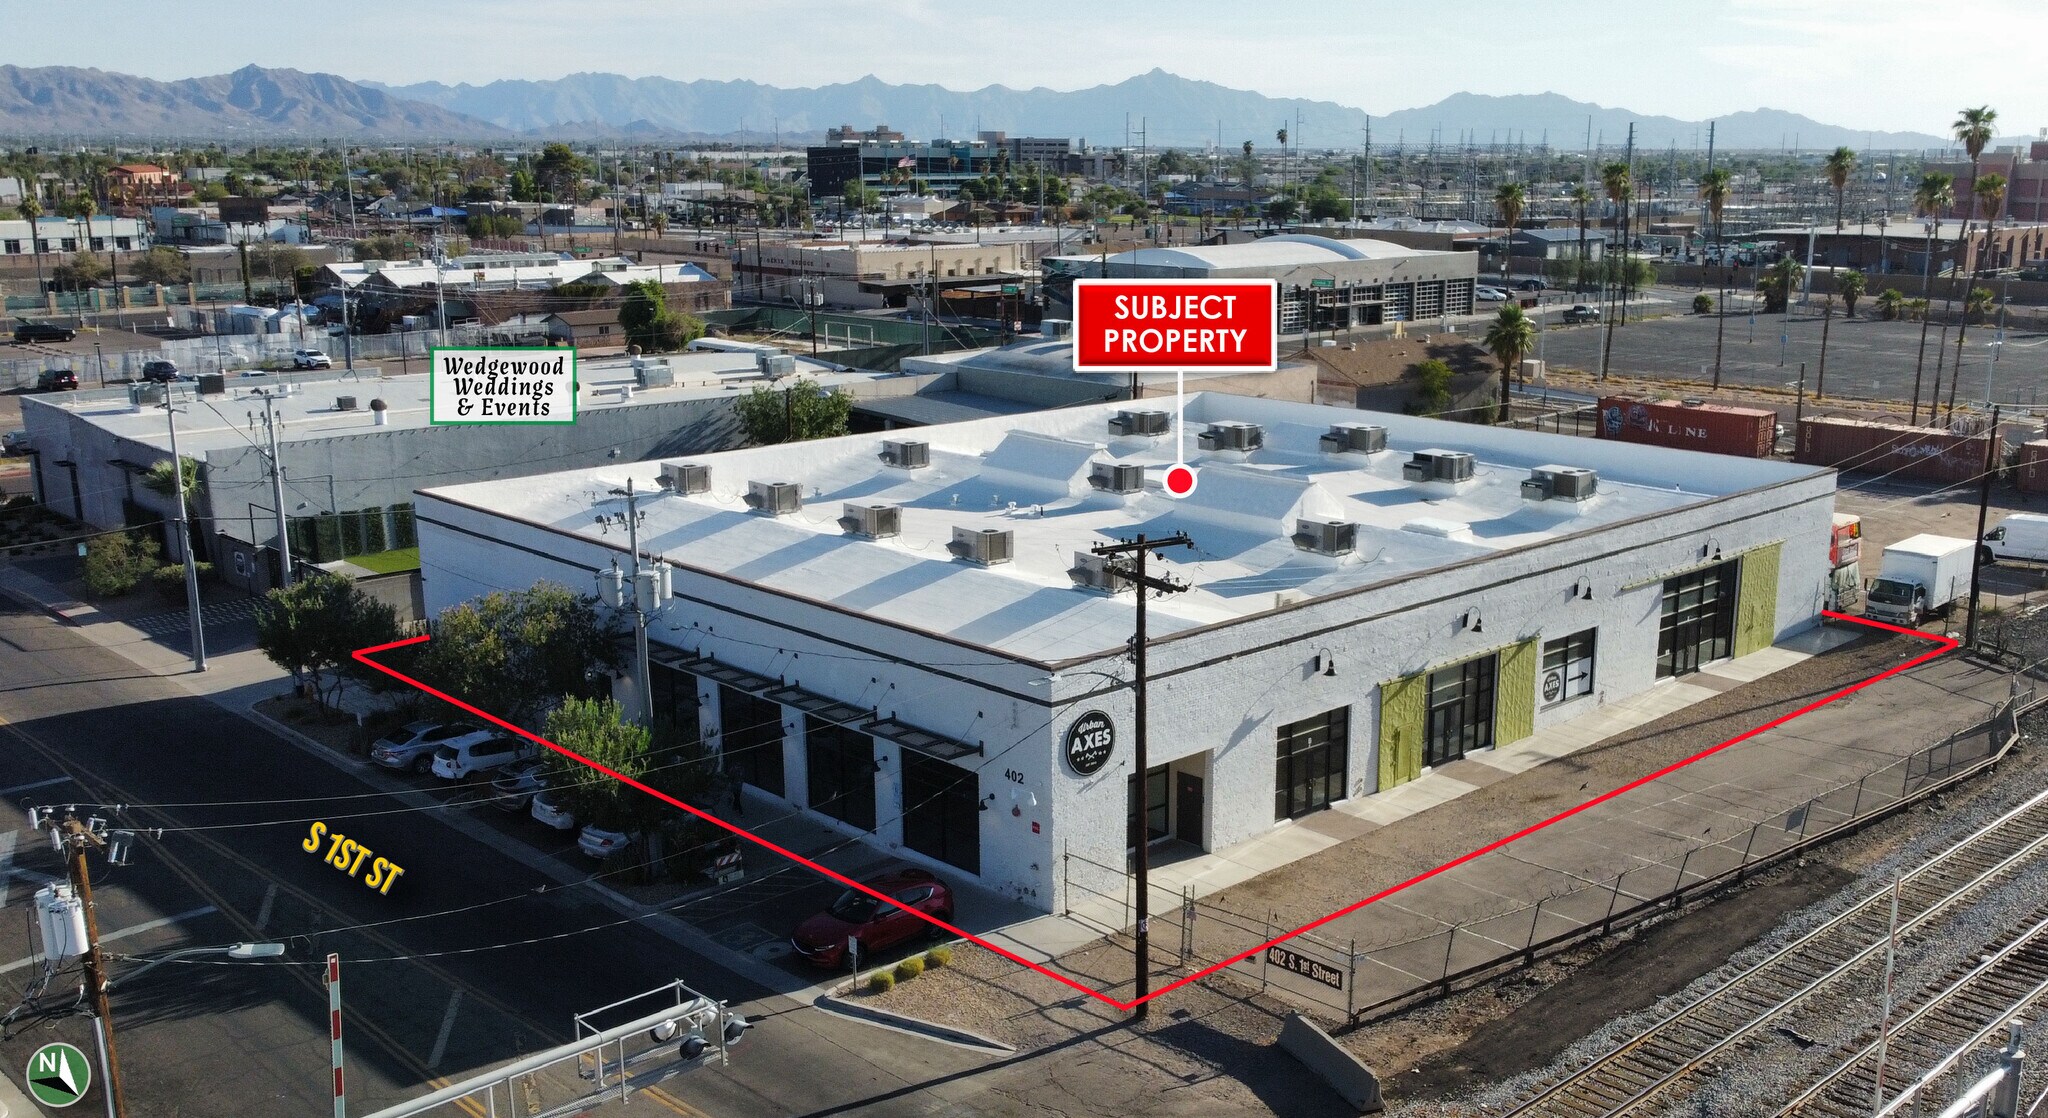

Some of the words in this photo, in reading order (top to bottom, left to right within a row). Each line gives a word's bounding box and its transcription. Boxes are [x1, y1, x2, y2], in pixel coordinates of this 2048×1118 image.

[1544, 680, 1560, 693] AXES
[1071, 729, 1111, 754] AXES
[1005, 768, 1024, 784] 402
[1269, 948, 1286, 966] 402
[1288, 954, 1297, 971] S.
[1299, 959, 1310, 973] 1st
[1312, 963, 1340, 987] Street
